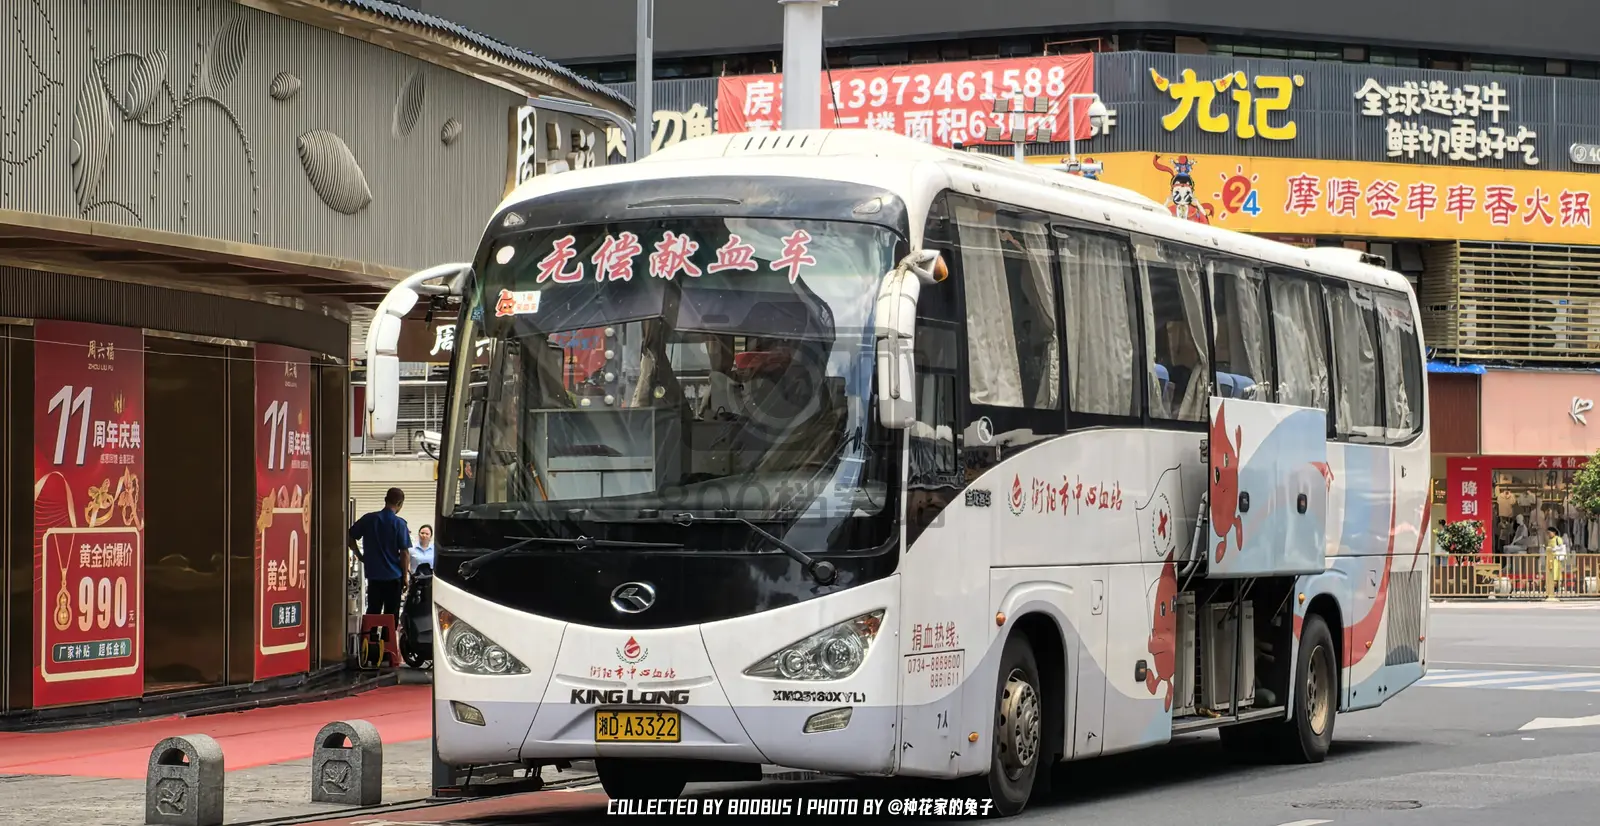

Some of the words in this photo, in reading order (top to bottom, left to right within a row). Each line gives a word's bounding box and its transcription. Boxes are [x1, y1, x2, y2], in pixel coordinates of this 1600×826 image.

[743, 80, 783, 117] 房
[827, 66, 1065, 111] 13973461588
[1161, 68, 1297, 140] 九记
[1354, 78, 1510, 123] 全球选好牛
[1386, 118, 1539, 165] 鲜切更好吃
[1284, 173, 1592, 228] 摩情签串串香火锅
[536, 230, 817, 284] 无偿献血车
[47, 385, 93, 465] 11
[93, 420, 141, 449] 周年庆典
[263, 400, 289, 470] 11
[80, 543, 133, 568] 黄金惊爆价
[78, 576, 127, 632] 990
[58, 644, 91, 660] 厂家补贴
[570, 689, 623, 705] KING
[626, 689, 690, 705] LONG
